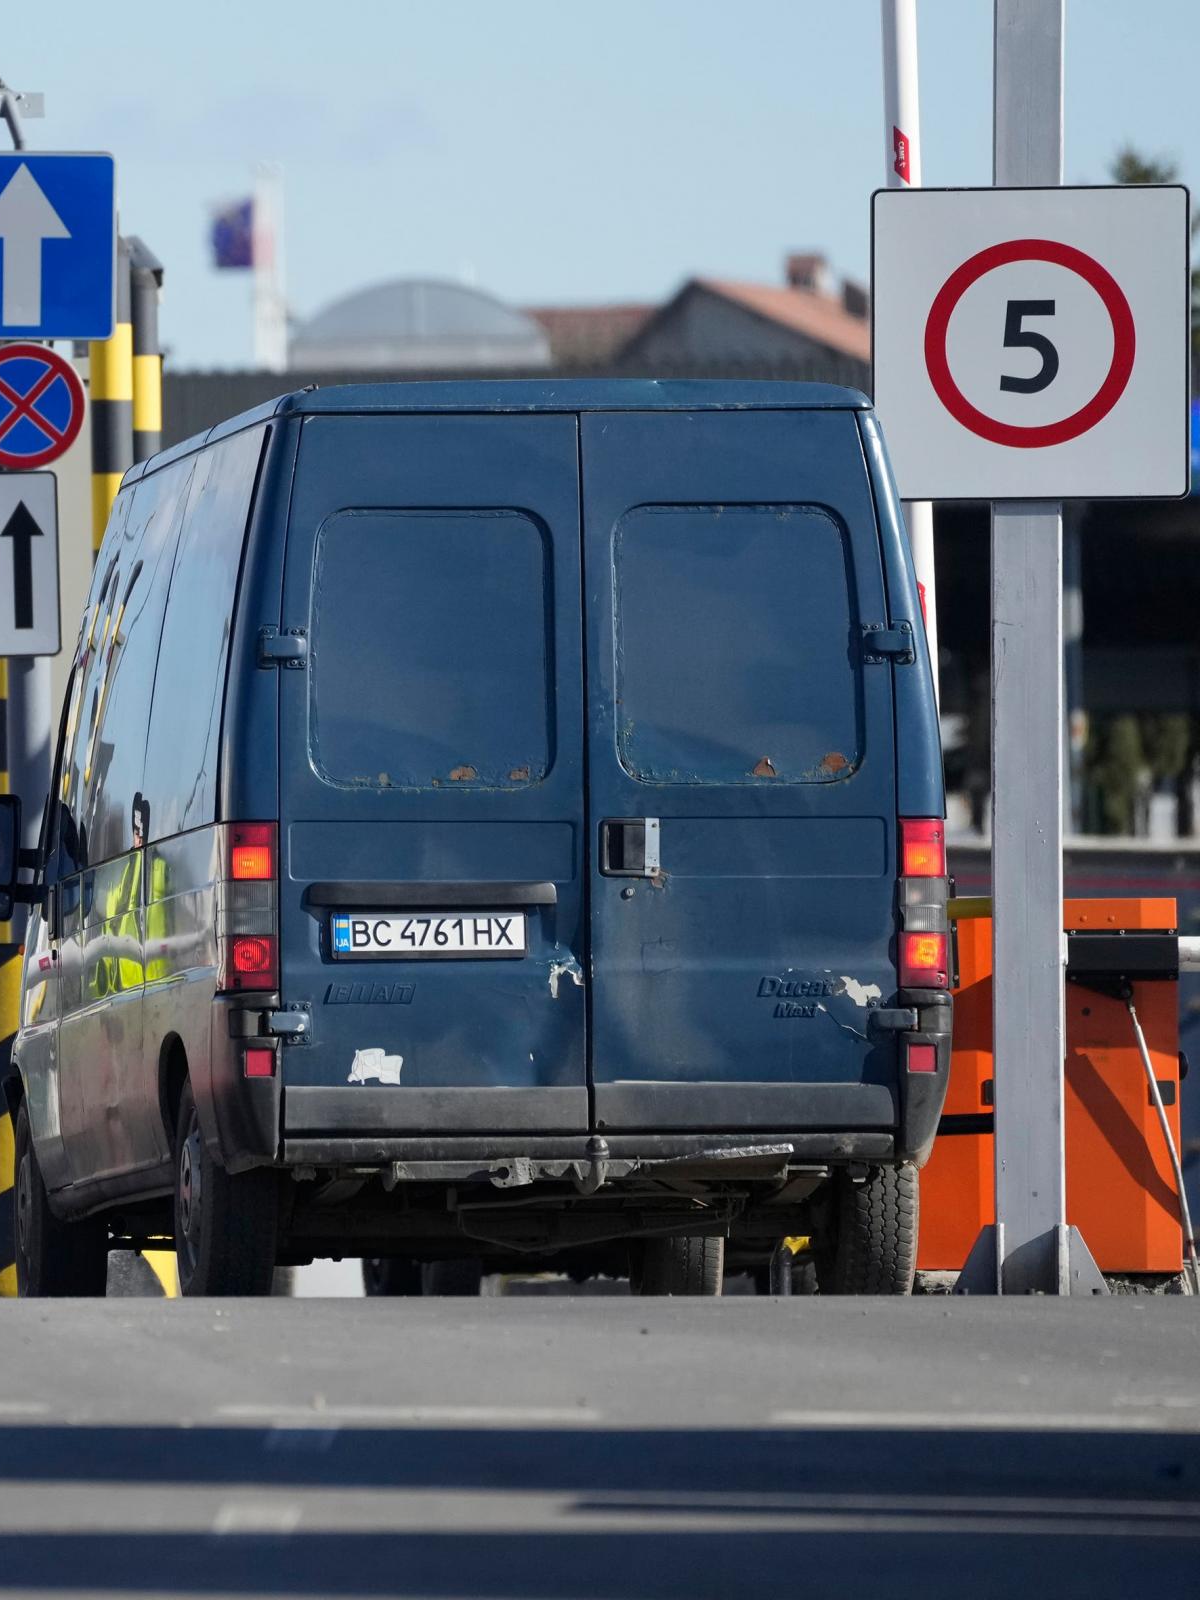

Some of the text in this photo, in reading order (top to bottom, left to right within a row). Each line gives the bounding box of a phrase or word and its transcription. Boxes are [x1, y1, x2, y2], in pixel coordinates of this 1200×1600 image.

[1000, 299, 1060, 394] 5
[336, 938, 349, 948] UA
[351, 918, 514, 948] BC 4761 HX
[328, 983, 415, 1003] FIAT
[757, 975, 843, 998] Ducat
[773, 1001, 818, 1019] Maxi
